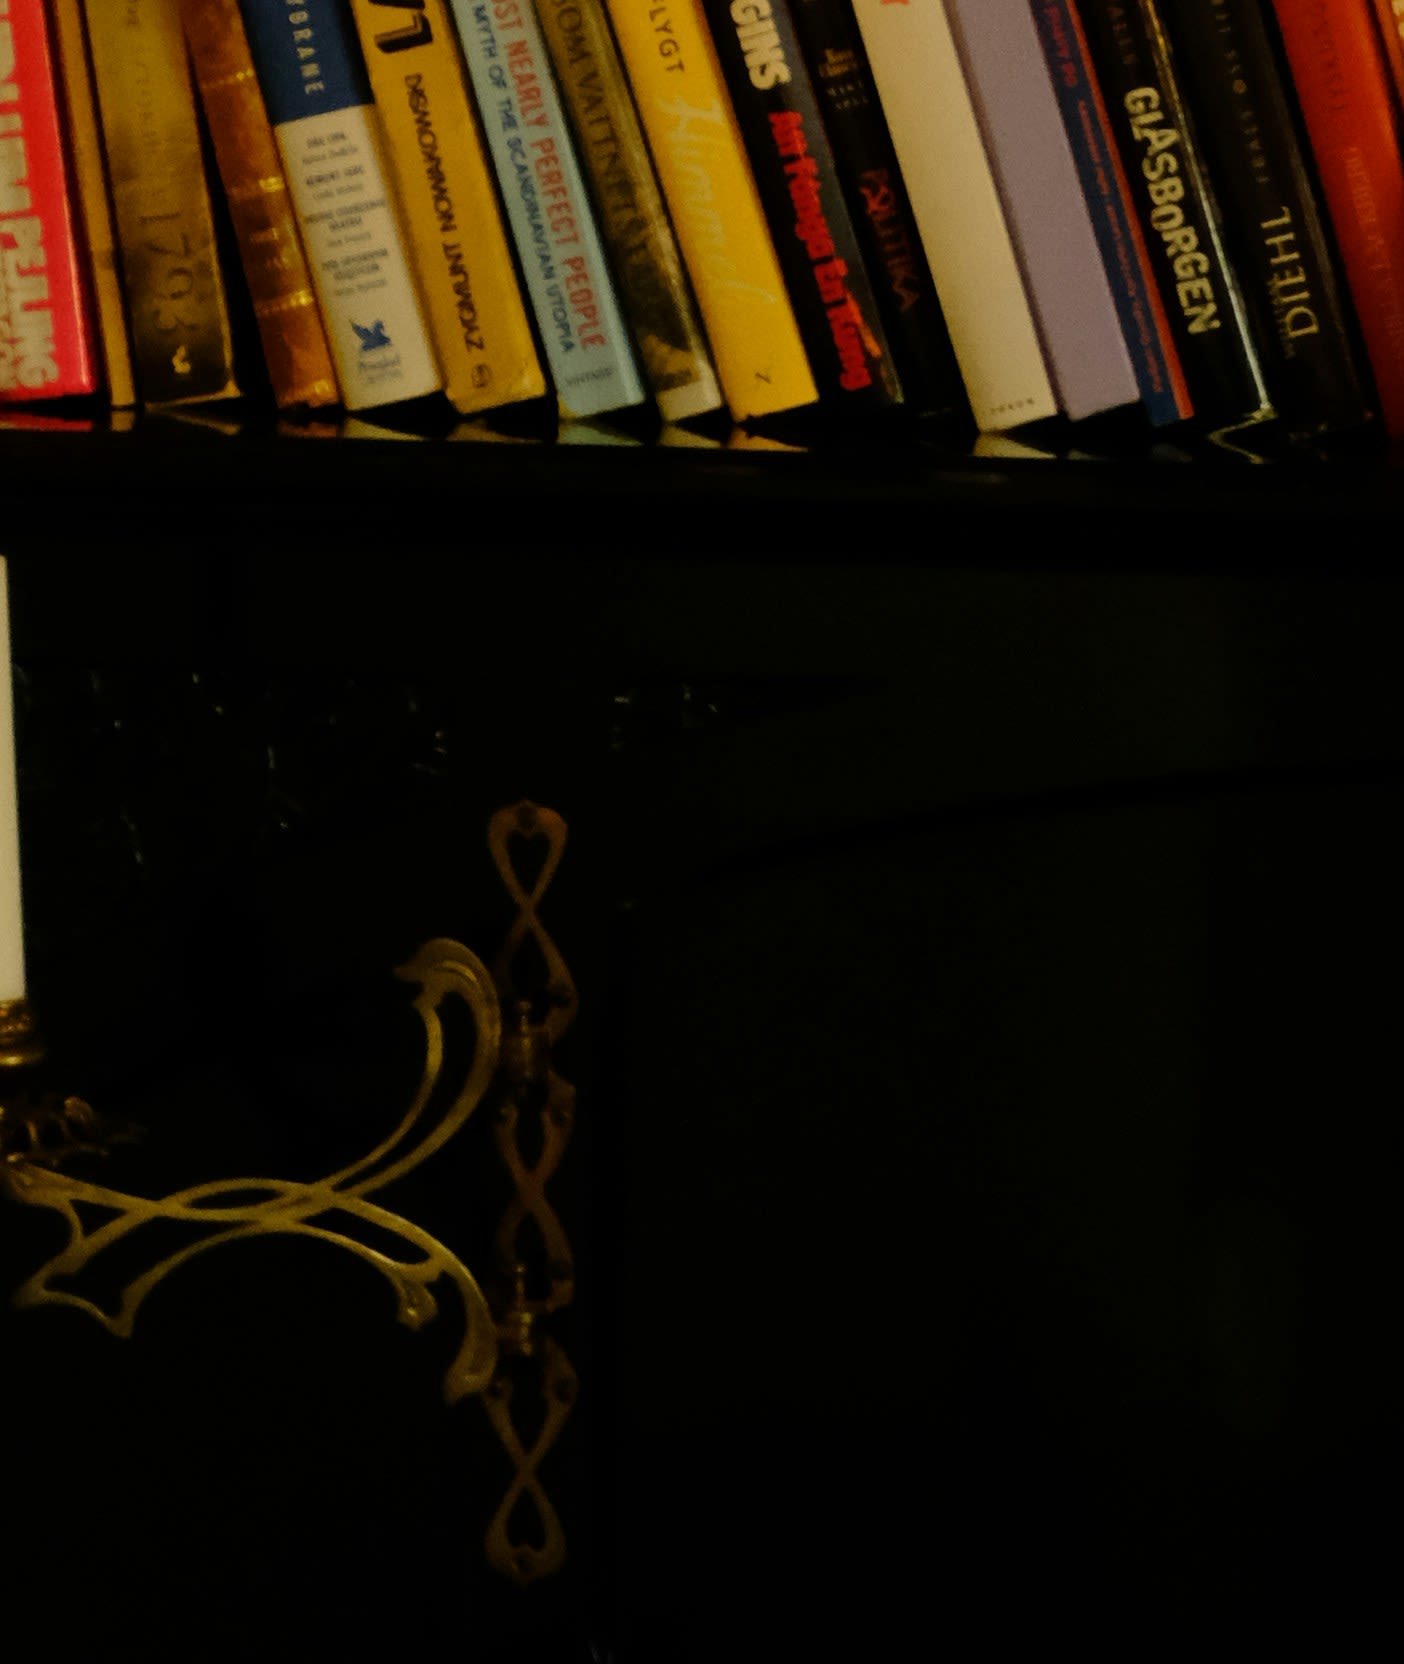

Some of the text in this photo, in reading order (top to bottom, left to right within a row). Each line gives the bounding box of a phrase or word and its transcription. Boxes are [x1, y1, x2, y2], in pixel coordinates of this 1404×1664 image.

[471, 3, 500, 59] MYTH
[487, 63, 507, 91] OF
[496, 99, 518, 134] THE
[404, 73, 483, 352] ZYGMUNT NOWAKOWSKI
[502, 38, 551, 132] NEARLY
[528, 136, 579, 248] PERFECT
[558, 254, 607, 351] PEOPLE
[506, 135, 556, 281] SCANDINAVIAN
[1118, 80, 1225, 338] GLASBORGEN
[545, 284, 576, 353] UTOPIA
[811, 257, 855, 305] En
[1253, 204, 1322, 342] DIEHL
